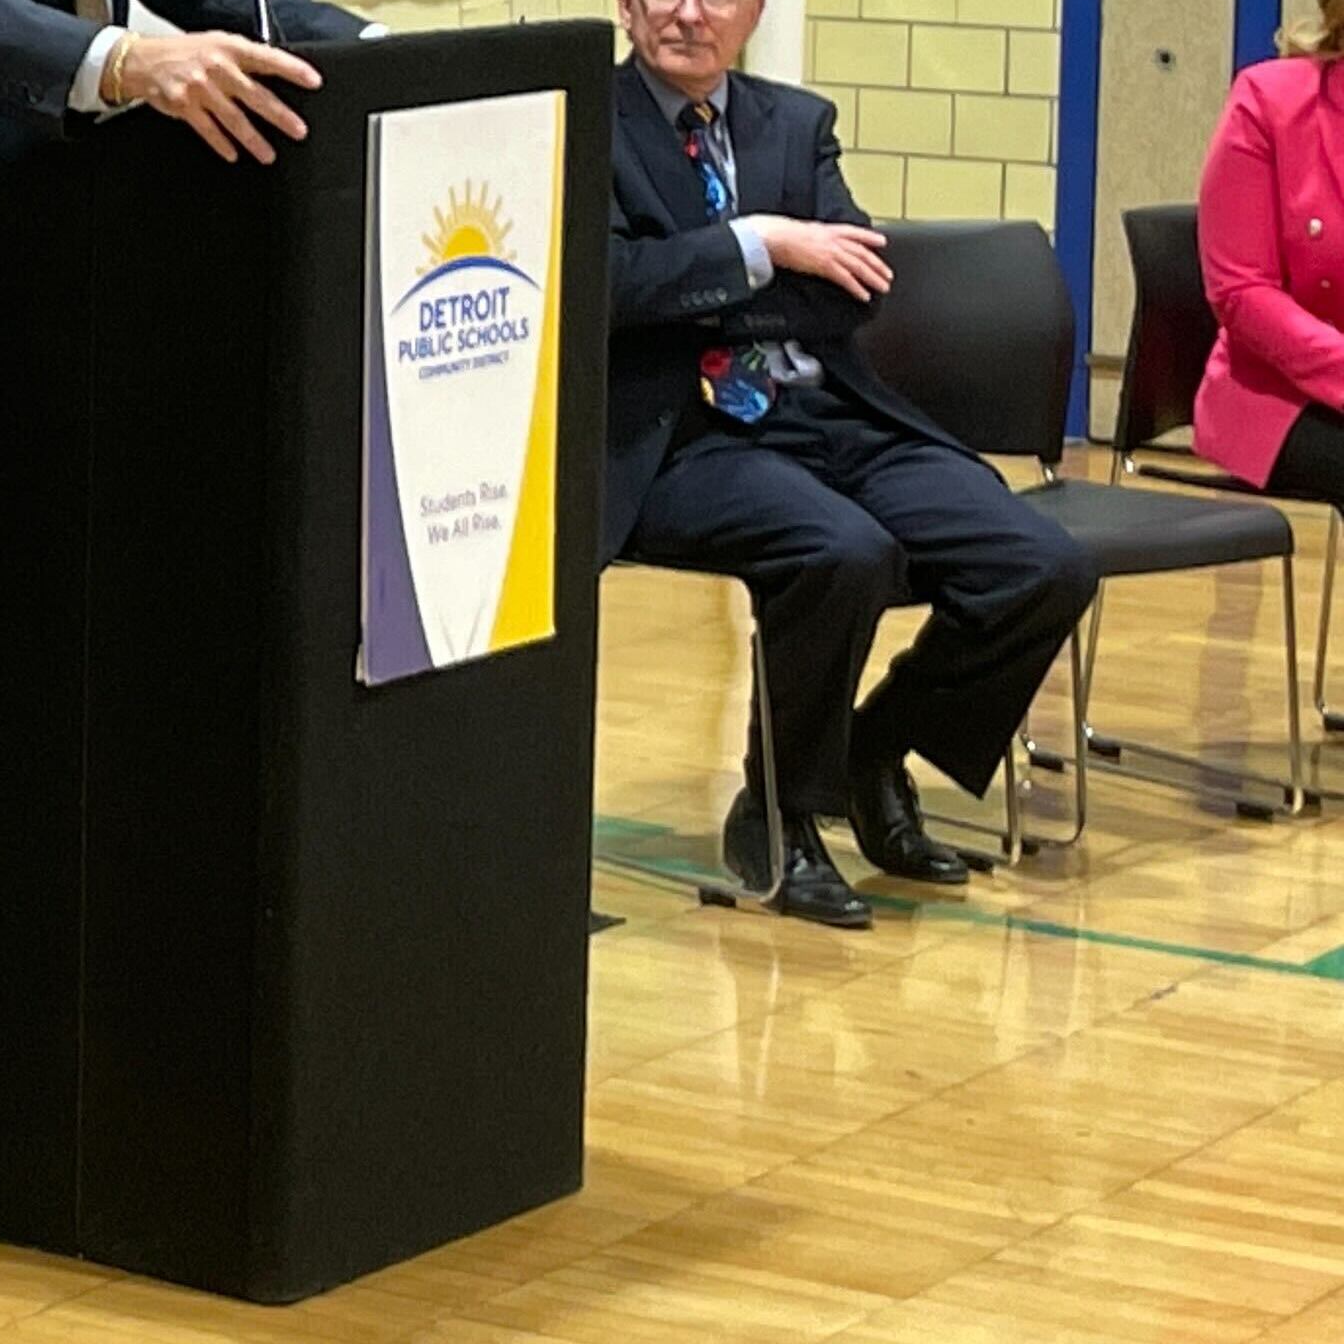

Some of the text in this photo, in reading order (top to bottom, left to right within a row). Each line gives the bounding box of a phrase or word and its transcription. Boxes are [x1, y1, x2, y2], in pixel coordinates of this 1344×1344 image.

[420, 286, 510, 332] DETROIT
[398, 316, 529, 363] PUBLIC SCHOOLS
[420, 490, 476, 517] Students
